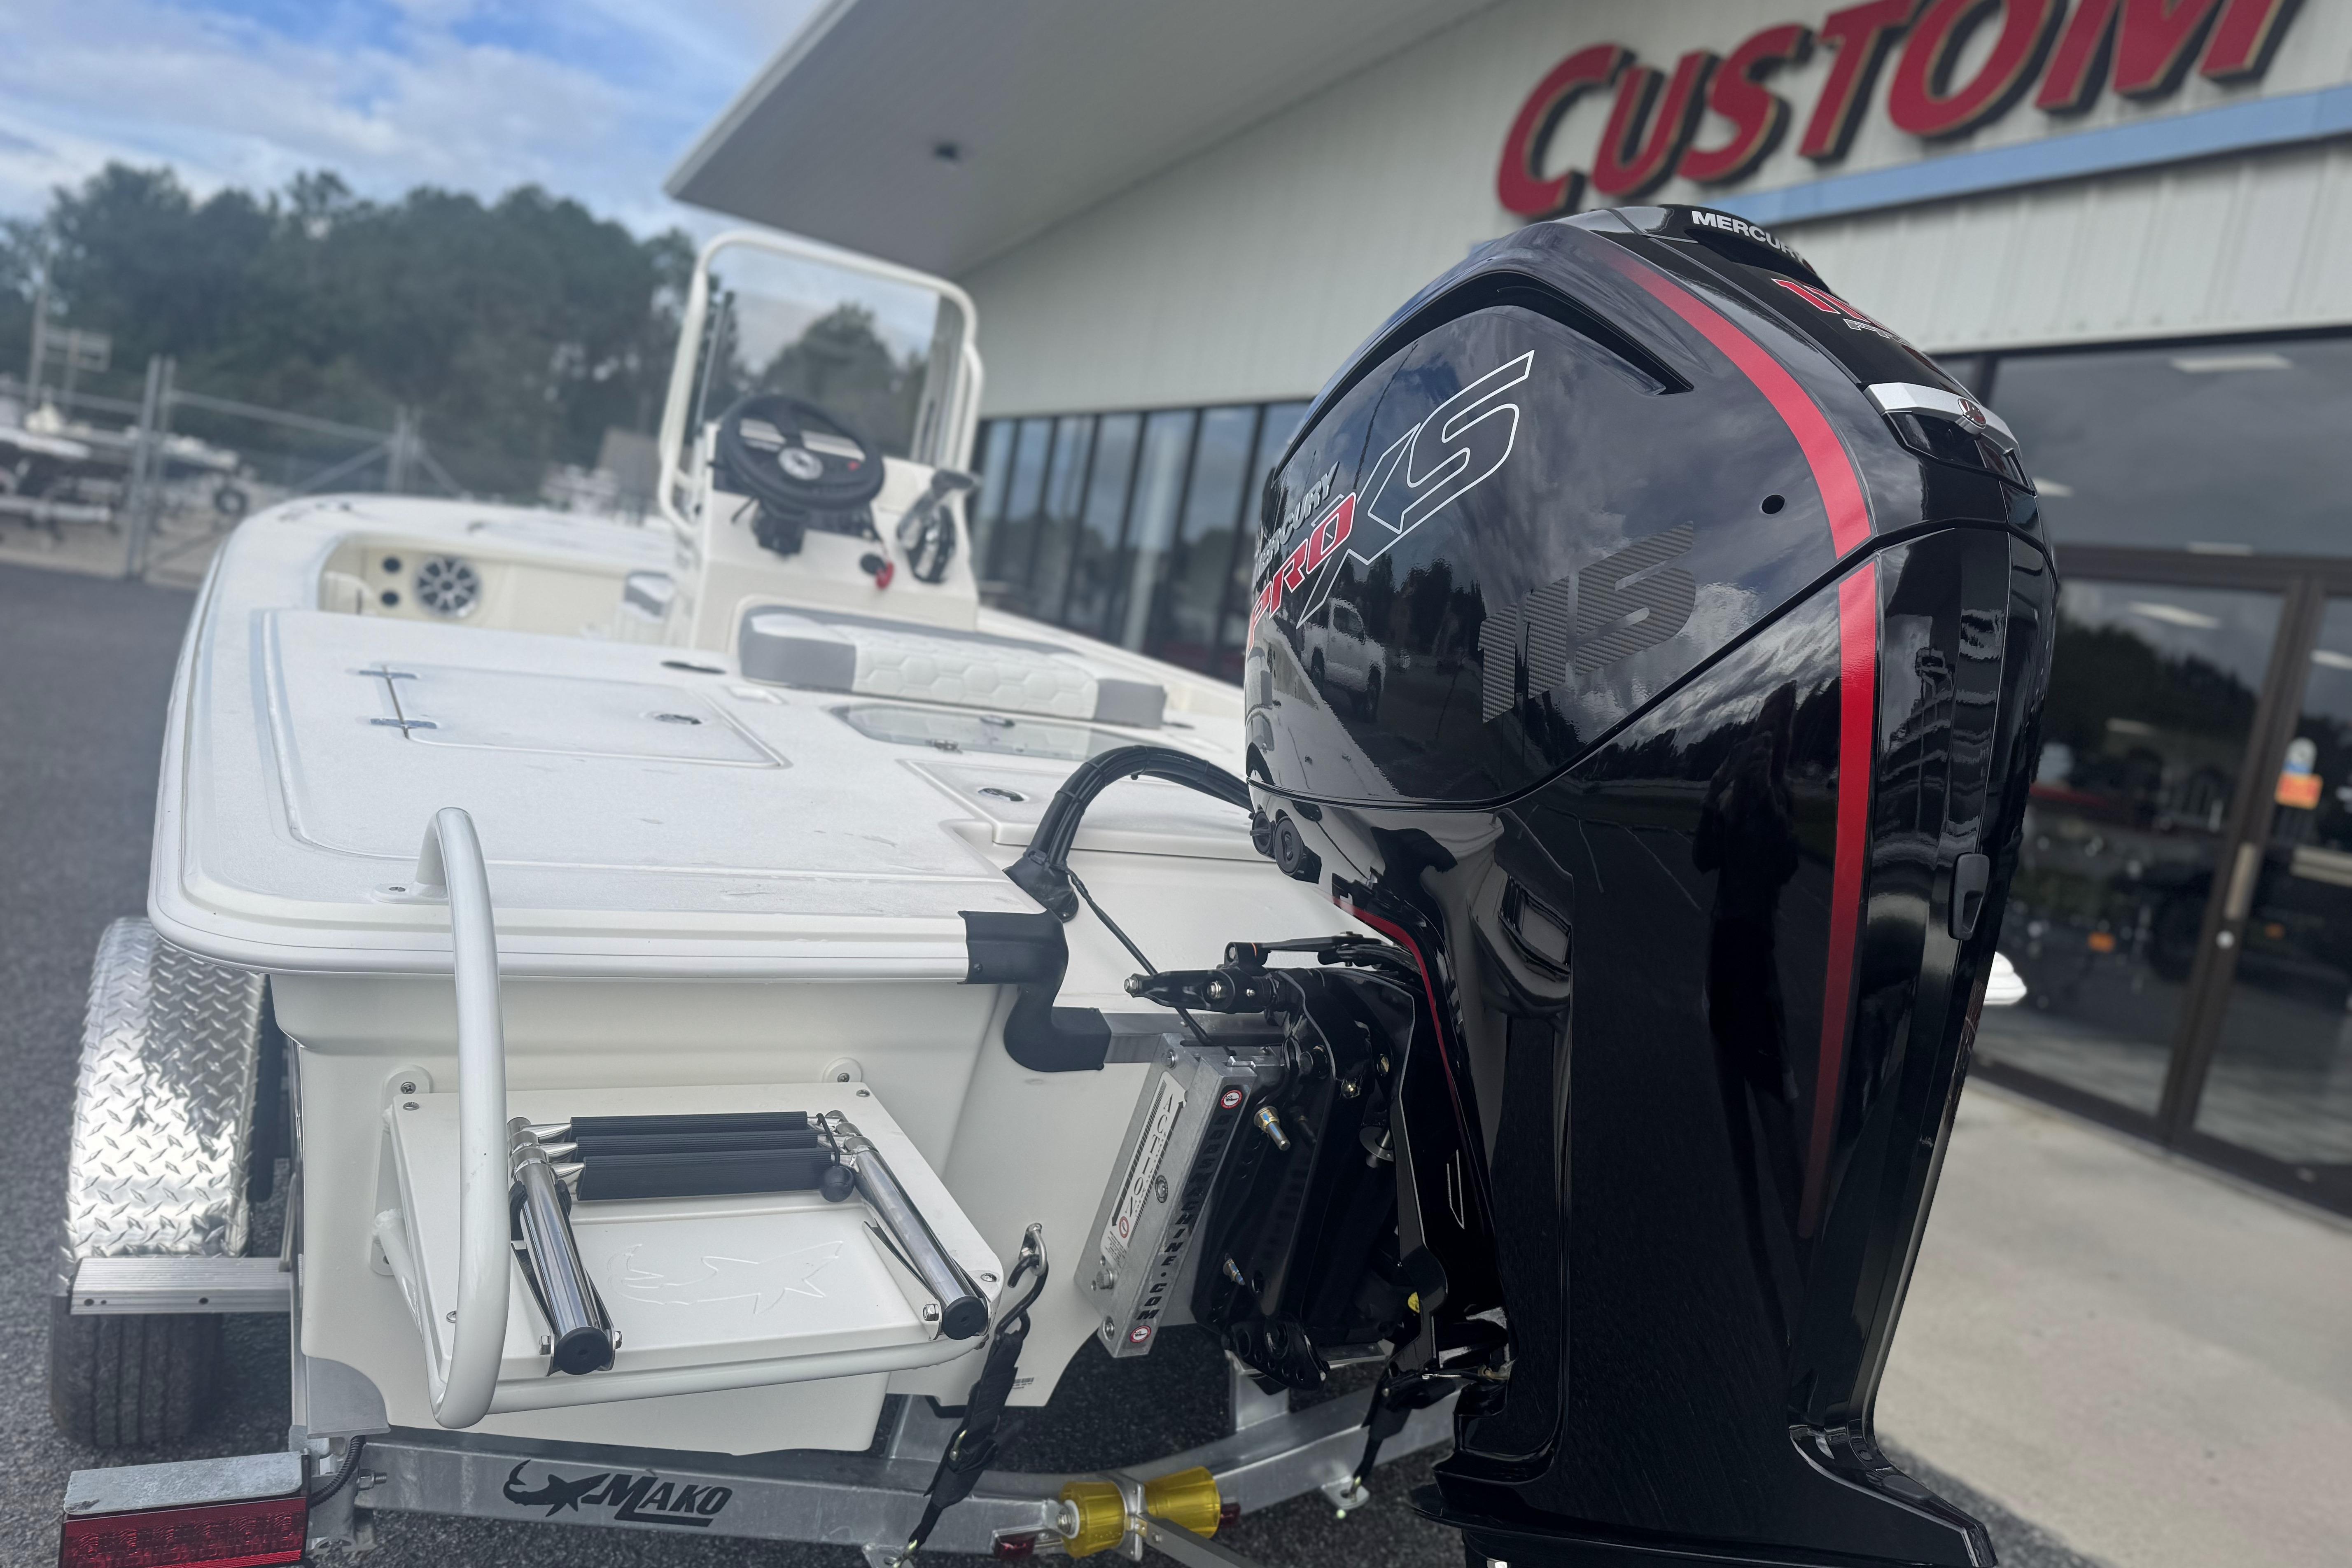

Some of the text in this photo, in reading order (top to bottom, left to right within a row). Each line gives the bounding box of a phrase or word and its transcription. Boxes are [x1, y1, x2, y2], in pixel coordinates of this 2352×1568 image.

[1246, 350, 1535, 659] PRO XS
[1255, 461, 1340, 581] ERCURY
[1478, 520, 1696, 724] 115
[1125, 1093, 1173, 1218] ACTION
[581, 1473, 733, 1527] MAKO
